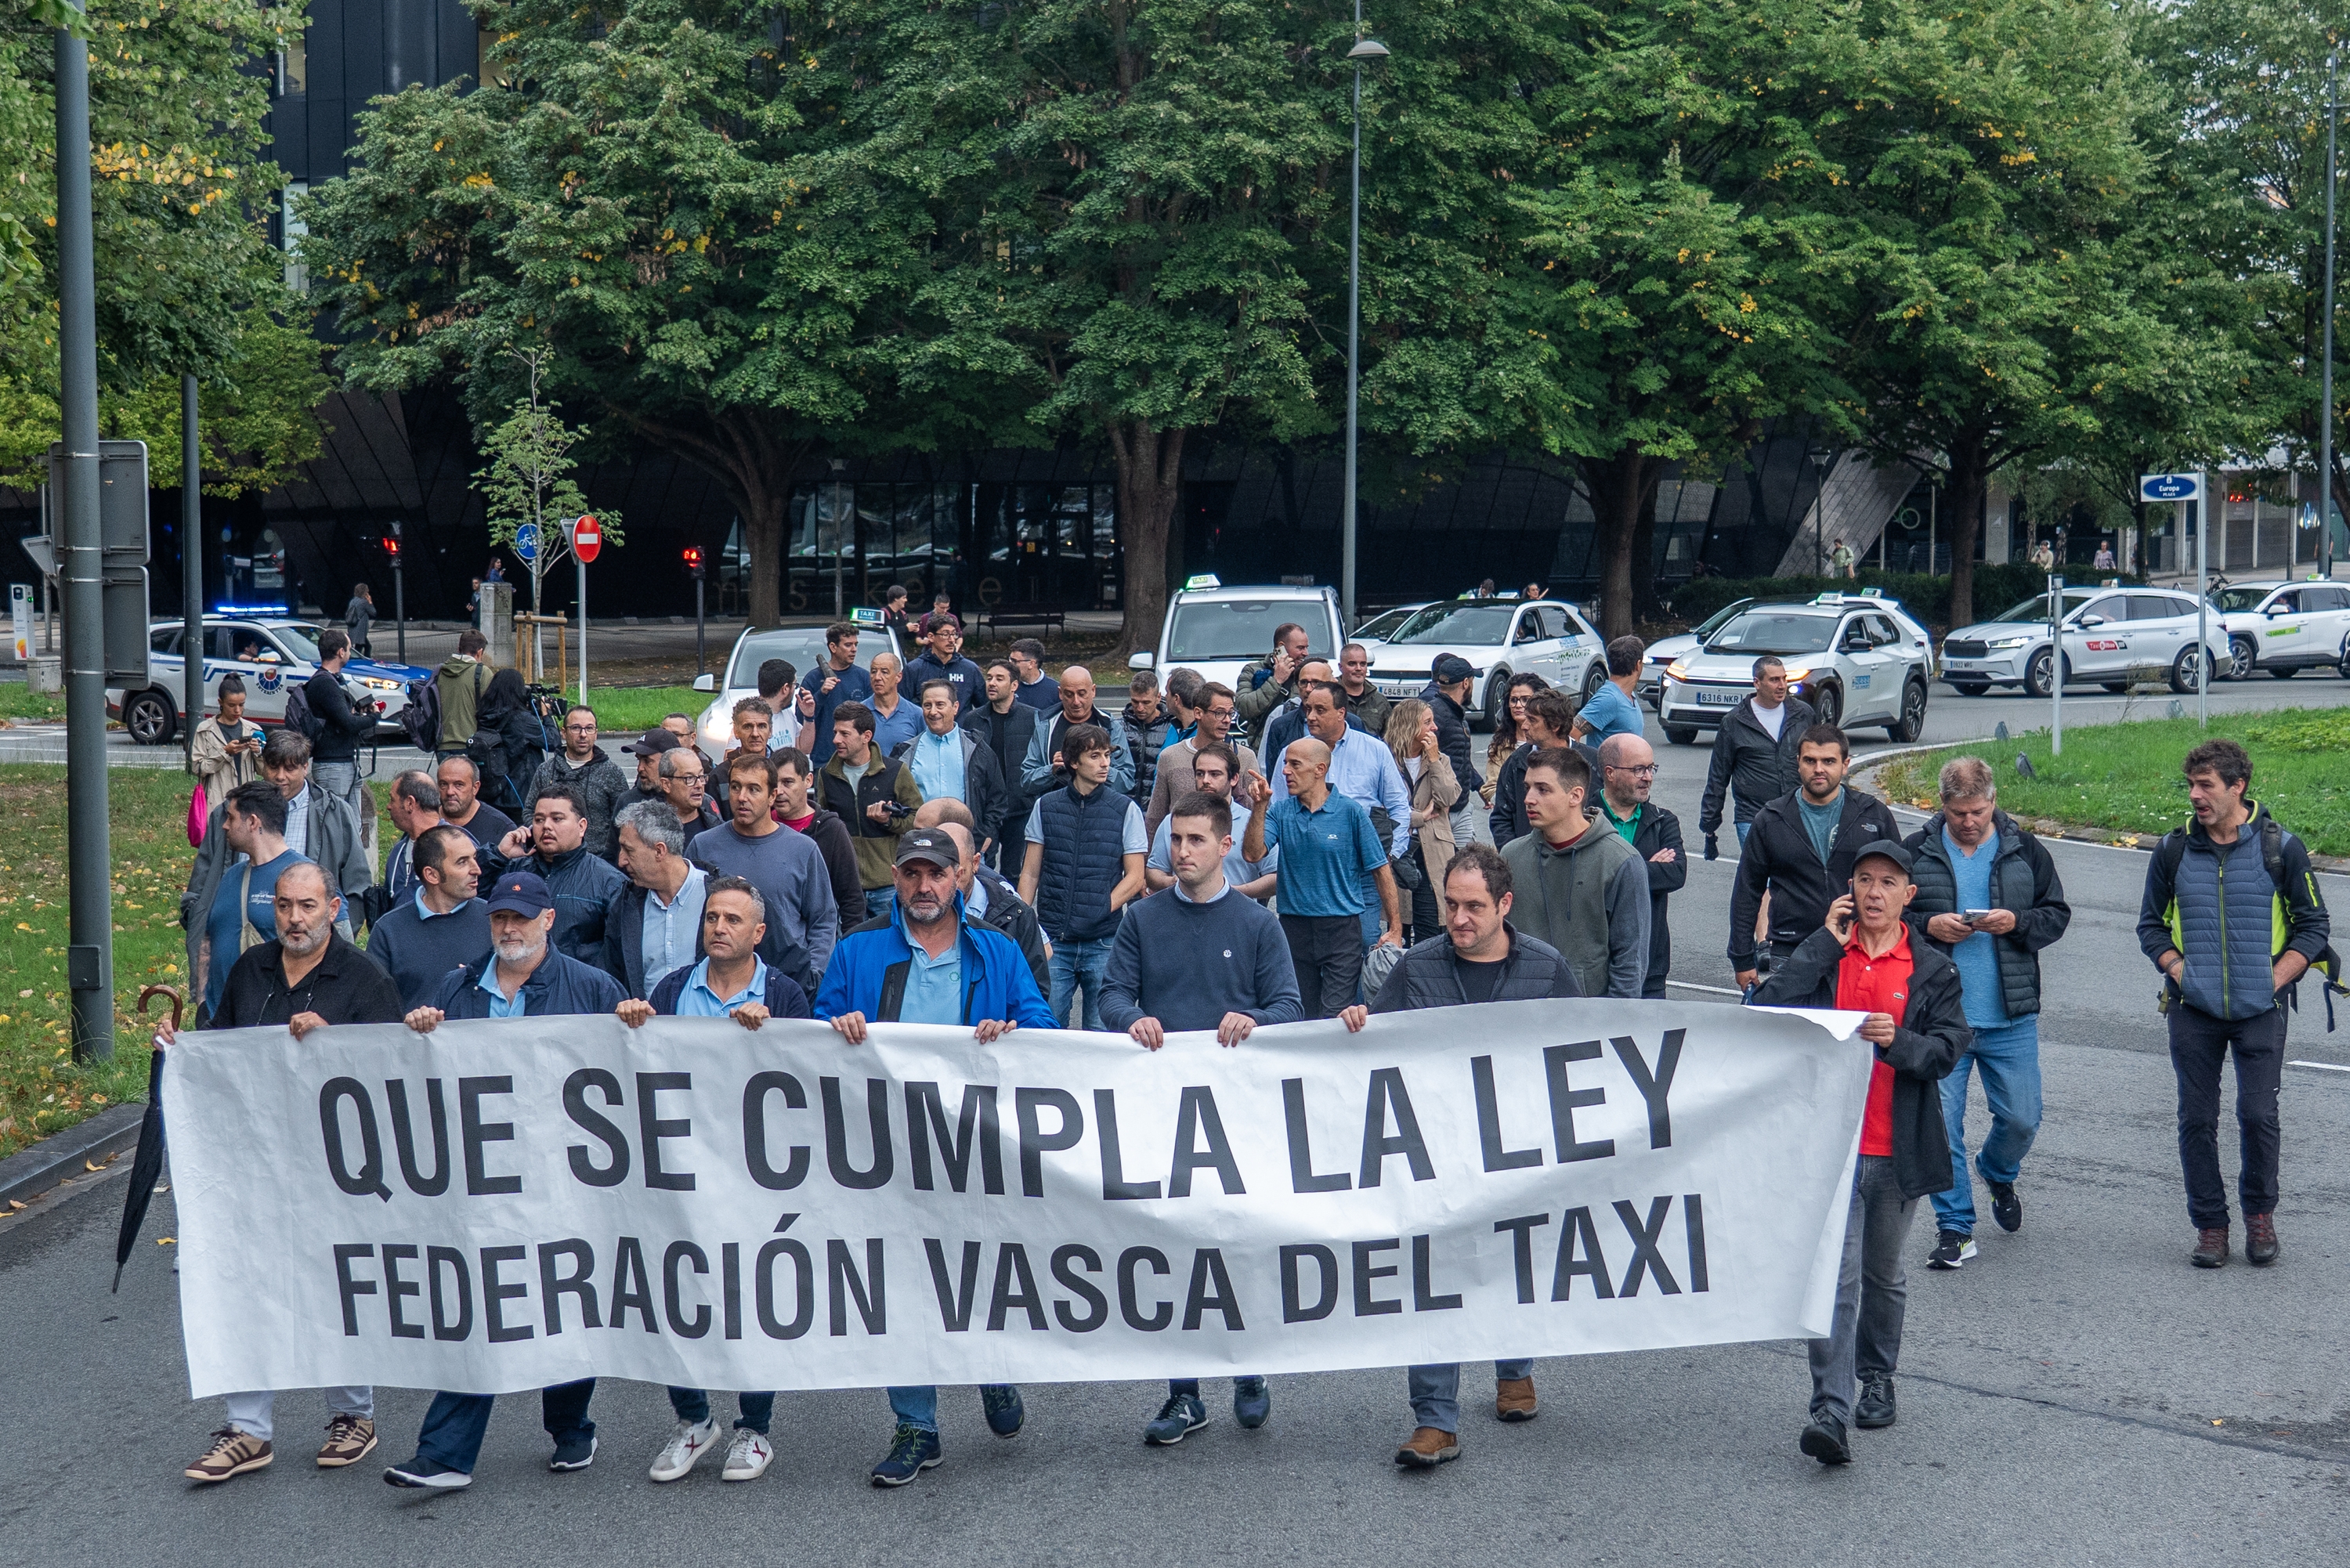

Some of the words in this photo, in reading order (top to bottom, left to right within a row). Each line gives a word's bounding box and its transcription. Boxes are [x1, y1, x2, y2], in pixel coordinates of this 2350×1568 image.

[949, 673, 964, 683] HH
[1383, 688, 1401, 696] 4848
[1701, 693, 1722, 703] 6316
[1723, 695, 1739, 703] NKR
[319, 1075, 522, 1204] QUE
[562, 1067, 696, 1191] SE
[742, 1071, 1246, 1201] CUMPLA
[1281, 1066, 1437, 1194] LA
[1470, 1027, 1688, 1173] LEY
[332, 1212, 888, 1344] FEDERACIÓN
[921, 1237, 1246, 1333] VASCA
[1278, 1234, 1463, 1324] DEL
[1493, 1193, 1710, 1305] TAXI
